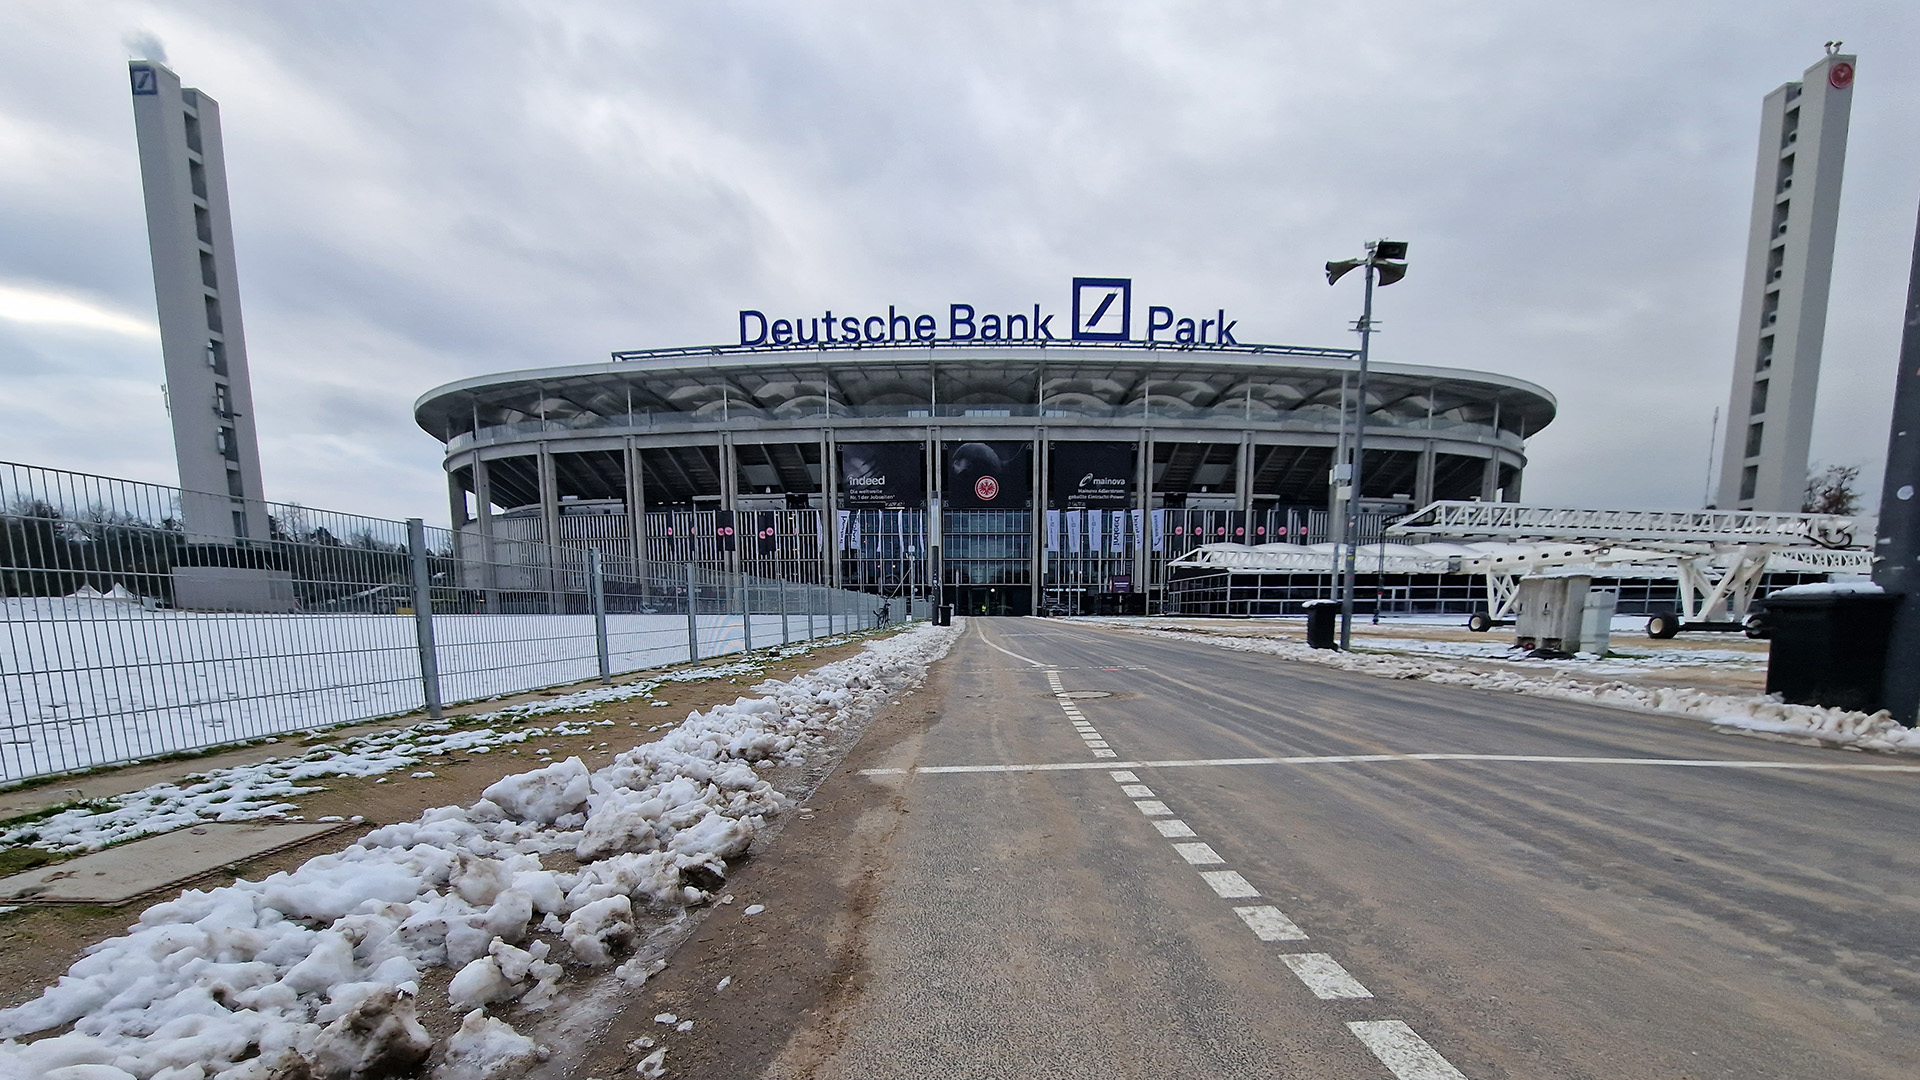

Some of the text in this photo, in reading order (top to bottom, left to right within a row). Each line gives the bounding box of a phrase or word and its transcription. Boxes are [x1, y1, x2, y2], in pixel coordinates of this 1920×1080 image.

[740, 303, 1238, 345] Deutsche Bank Park
[849, 475, 885, 486] indeed
[1093, 477, 1126, 485] mainova
